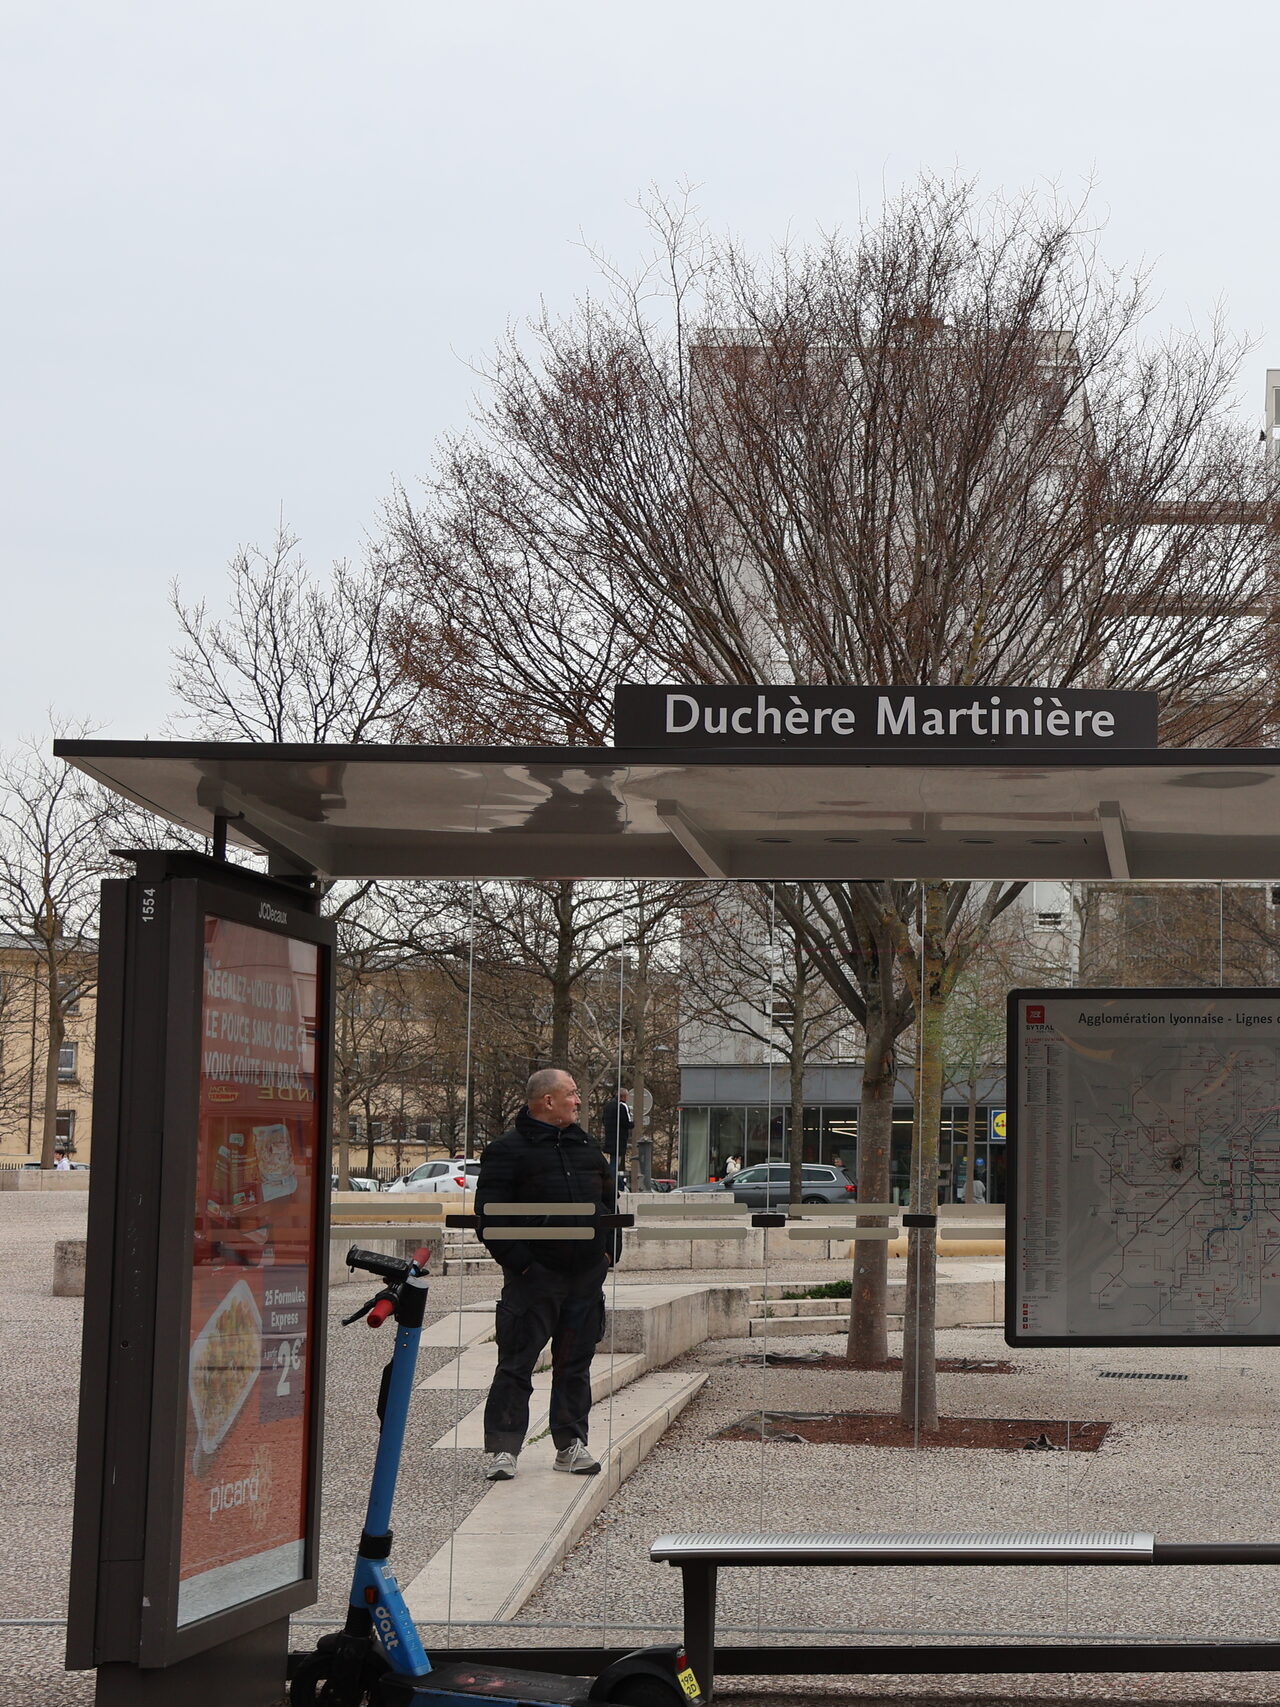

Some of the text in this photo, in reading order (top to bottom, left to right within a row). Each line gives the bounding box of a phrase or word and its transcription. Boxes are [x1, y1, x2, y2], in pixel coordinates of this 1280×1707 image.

[665, 693, 1116, 737] Duchère Martinière
[142, 887, 156, 923] 1554
[258, 901, 288, 925] JCDecaux
[207, 960, 292, 1013] RÉGALEZ-VOUS SUR
[205, 1009, 219, 1039] LE
[221, 1012, 250, 1044] POUCE
[252, 1018, 272, 1049] SANS
[274, 1023, 294, 1054] QUE
[1078, 1012, 1165, 1026] Agglomération
[1169, 1012, 1224, 1026] lyonnaise
[1236, 1012, 1273, 1027] Lignes
[204, 1051, 231, 1081] VOUS
[233, 1045, 260, 1085] COÛTE
[262, 1058, 275, 1087] UN
[265, 1286, 306, 1306] 25 Formules
[271, 1312, 299, 1331] Express
[209, 1468, 260, 1521] picard
[375, 1606, 399, 1651] dott
[681, 1673, 694, 1687] 198
[686, 1683, 697, 1695] 2D
